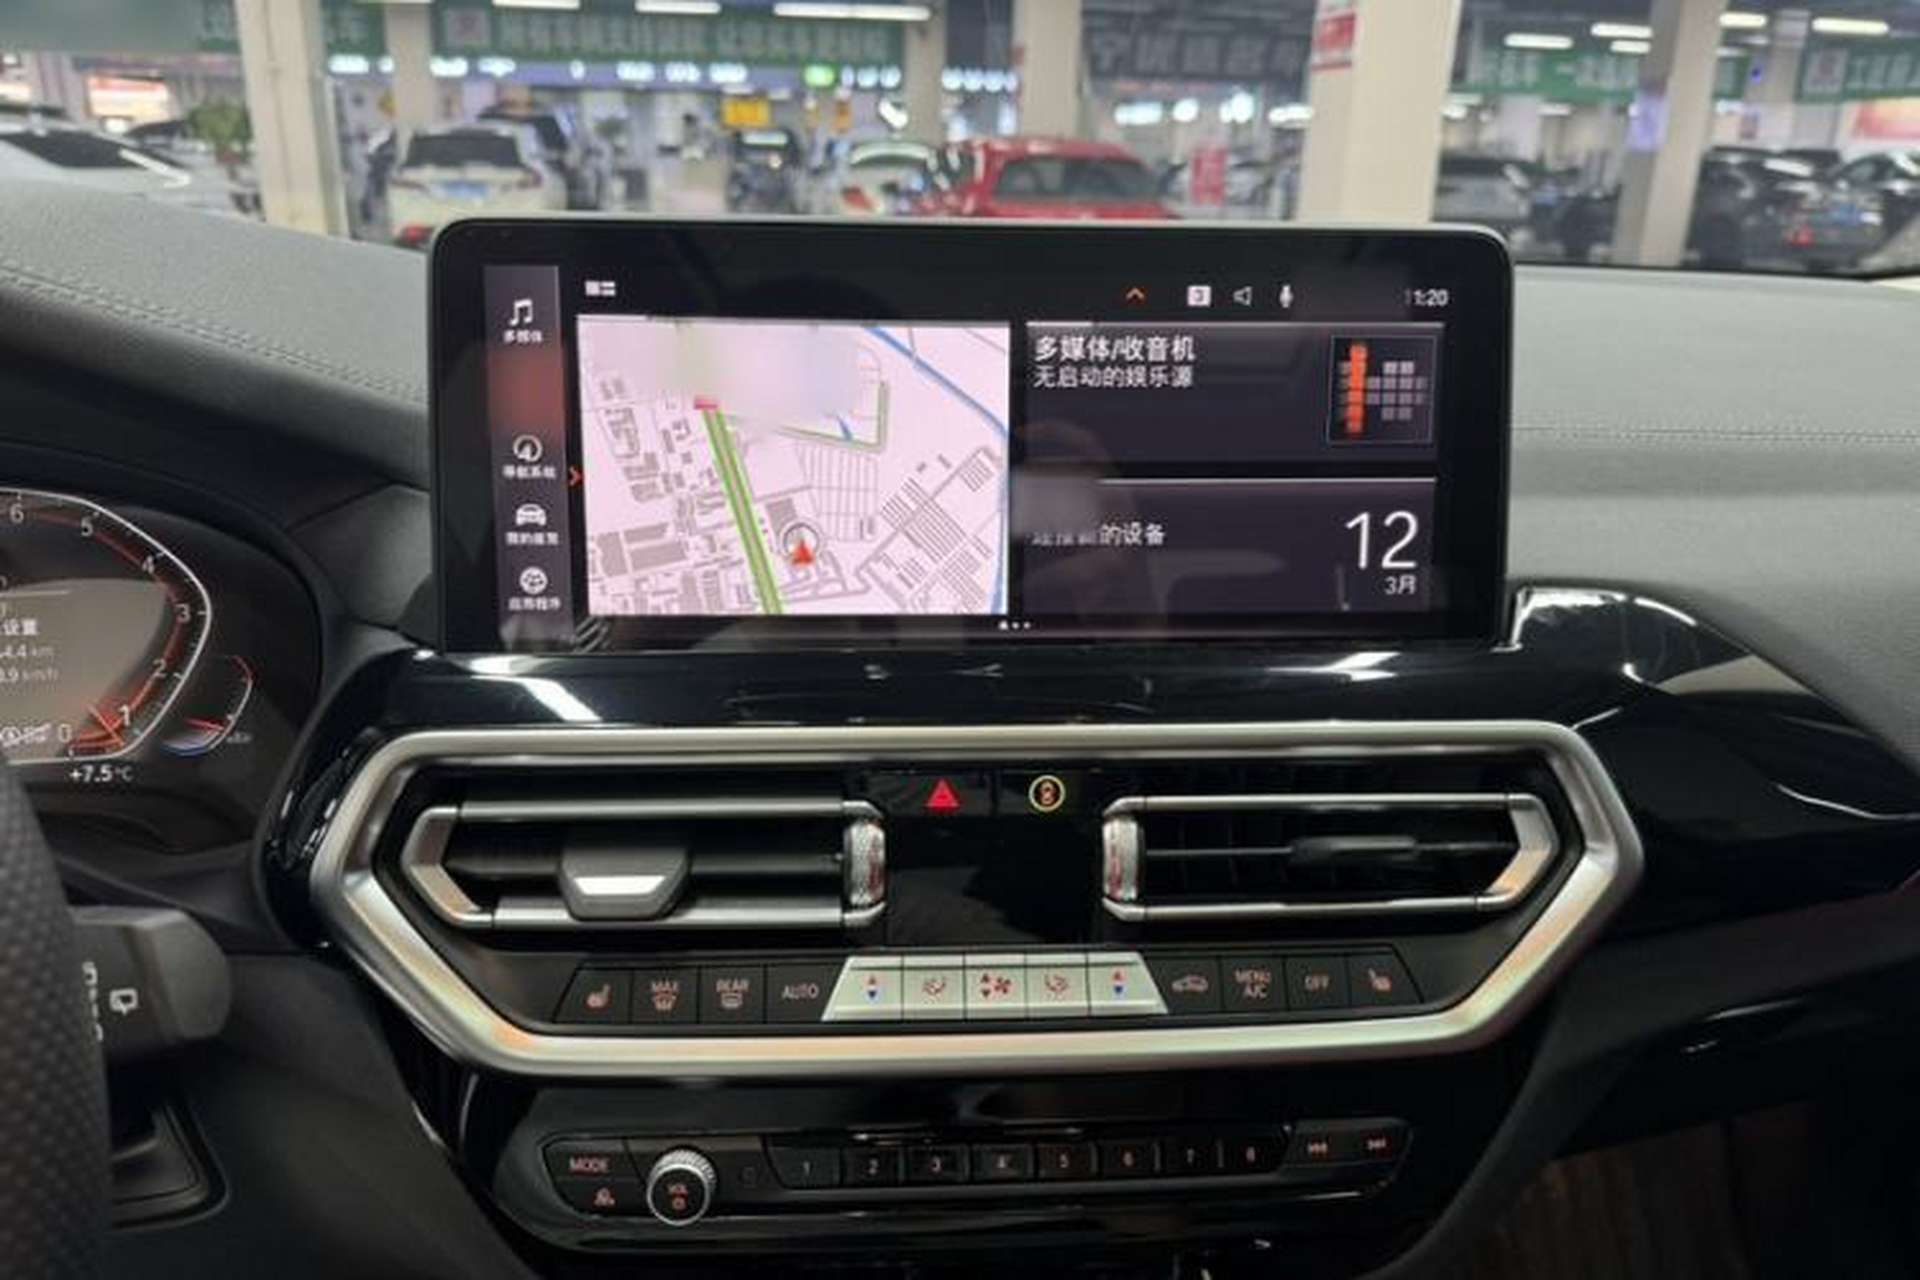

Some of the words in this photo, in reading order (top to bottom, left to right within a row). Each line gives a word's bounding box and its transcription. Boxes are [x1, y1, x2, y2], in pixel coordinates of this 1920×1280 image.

[1034, 335, 1197, 362] 多媒体/收音机
[1033, 365, 1194, 389] 无启动的娱乐源
[80, 517, 94, 537] 5
[1345, 510, 1419, 571] 12
[1384, 574, 1418, 596] 3月
[176, 603, 191, 622] 3
[781, 983, 820, 1000] AUTO
[1304, 974, 1330, 992] OFF
[569, 1156, 609, 1173] MODE
